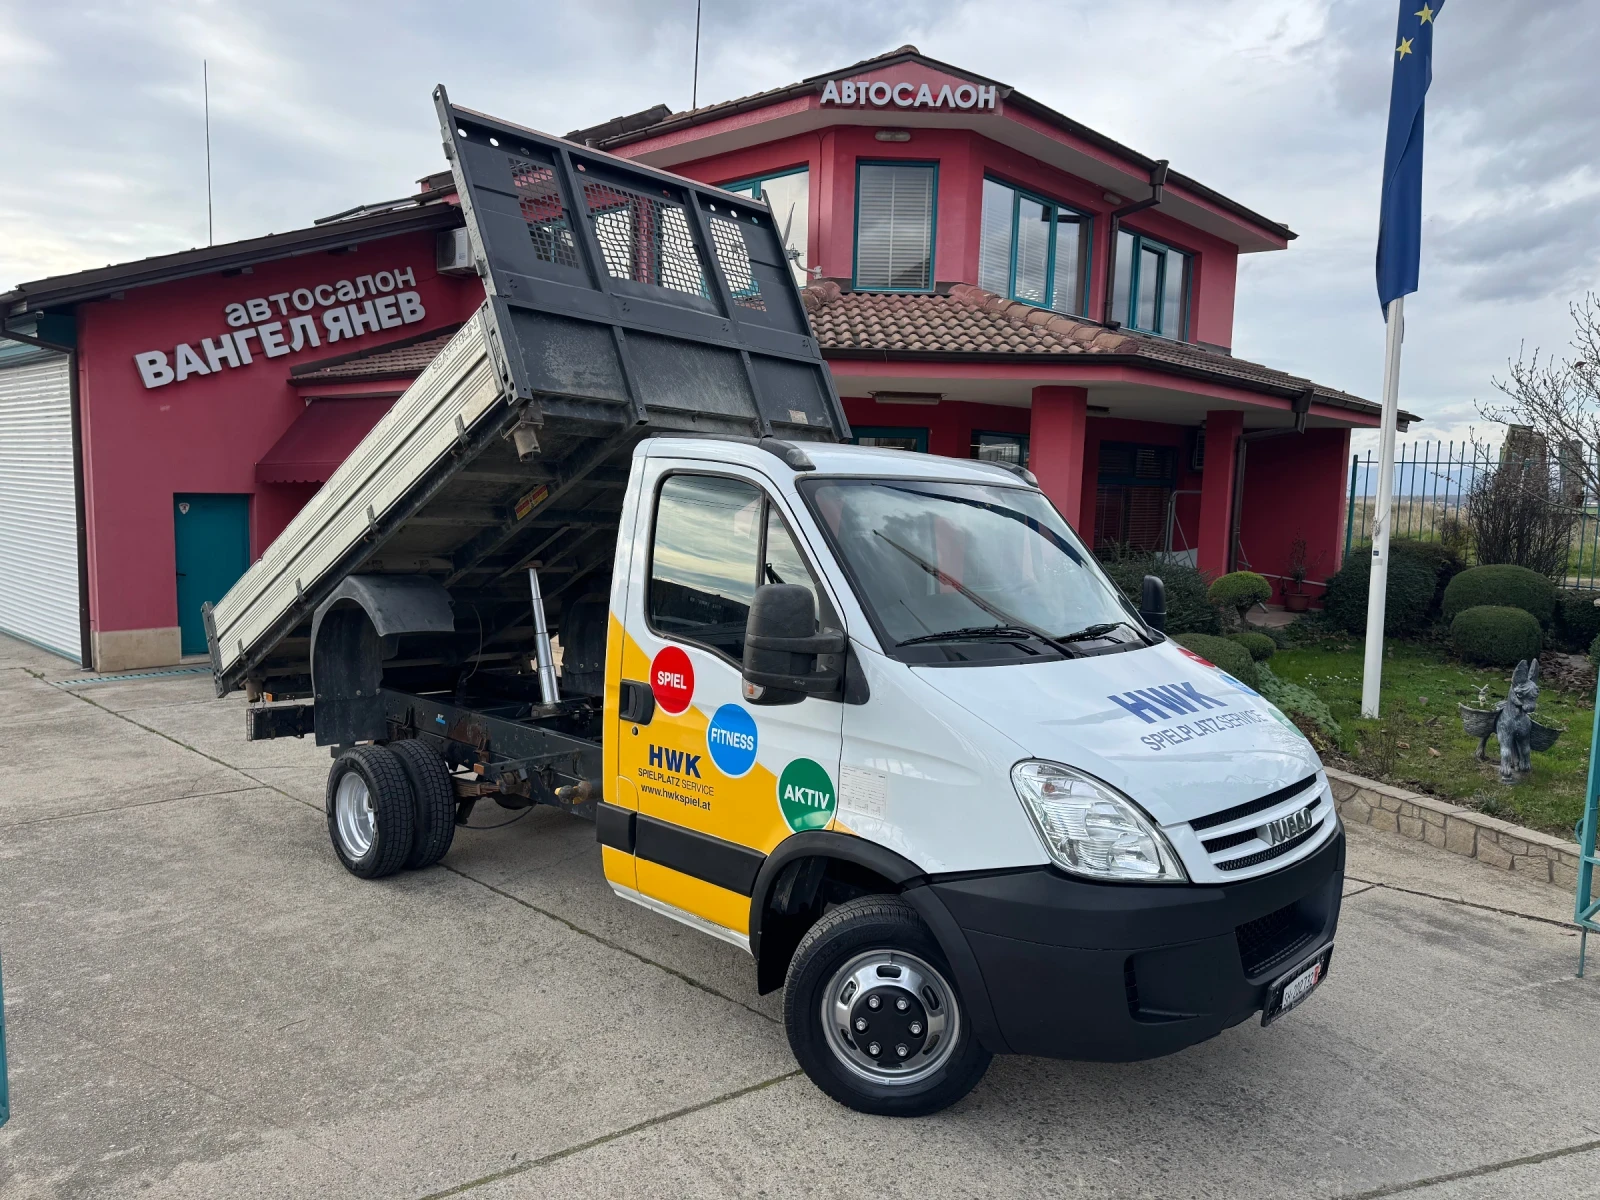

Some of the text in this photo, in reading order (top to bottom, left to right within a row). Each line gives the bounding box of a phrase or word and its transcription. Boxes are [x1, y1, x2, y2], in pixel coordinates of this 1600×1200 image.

[820, 80, 996, 109] АВТОСАЛОН
[225, 266, 417, 327] автосалон
[134, 291, 426, 389] ВАНГЕЛ ЯНЕВ
[657, 671, 687, 690] SPIEL
[1107, 682, 1228, 724] HWK
[711, 728, 754, 751] FITNESS
[1140, 710, 1268, 751] SPIELPLATZ SERVICE
[649, 744, 701, 778] HWK
[638, 767, 714, 797] SPIELPLATZ SERVICE
[641, 784, 711, 811] www.hwkspiel.at
[784, 783, 829, 809] AKTIV
[1269, 808, 1313, 844] IVECO
